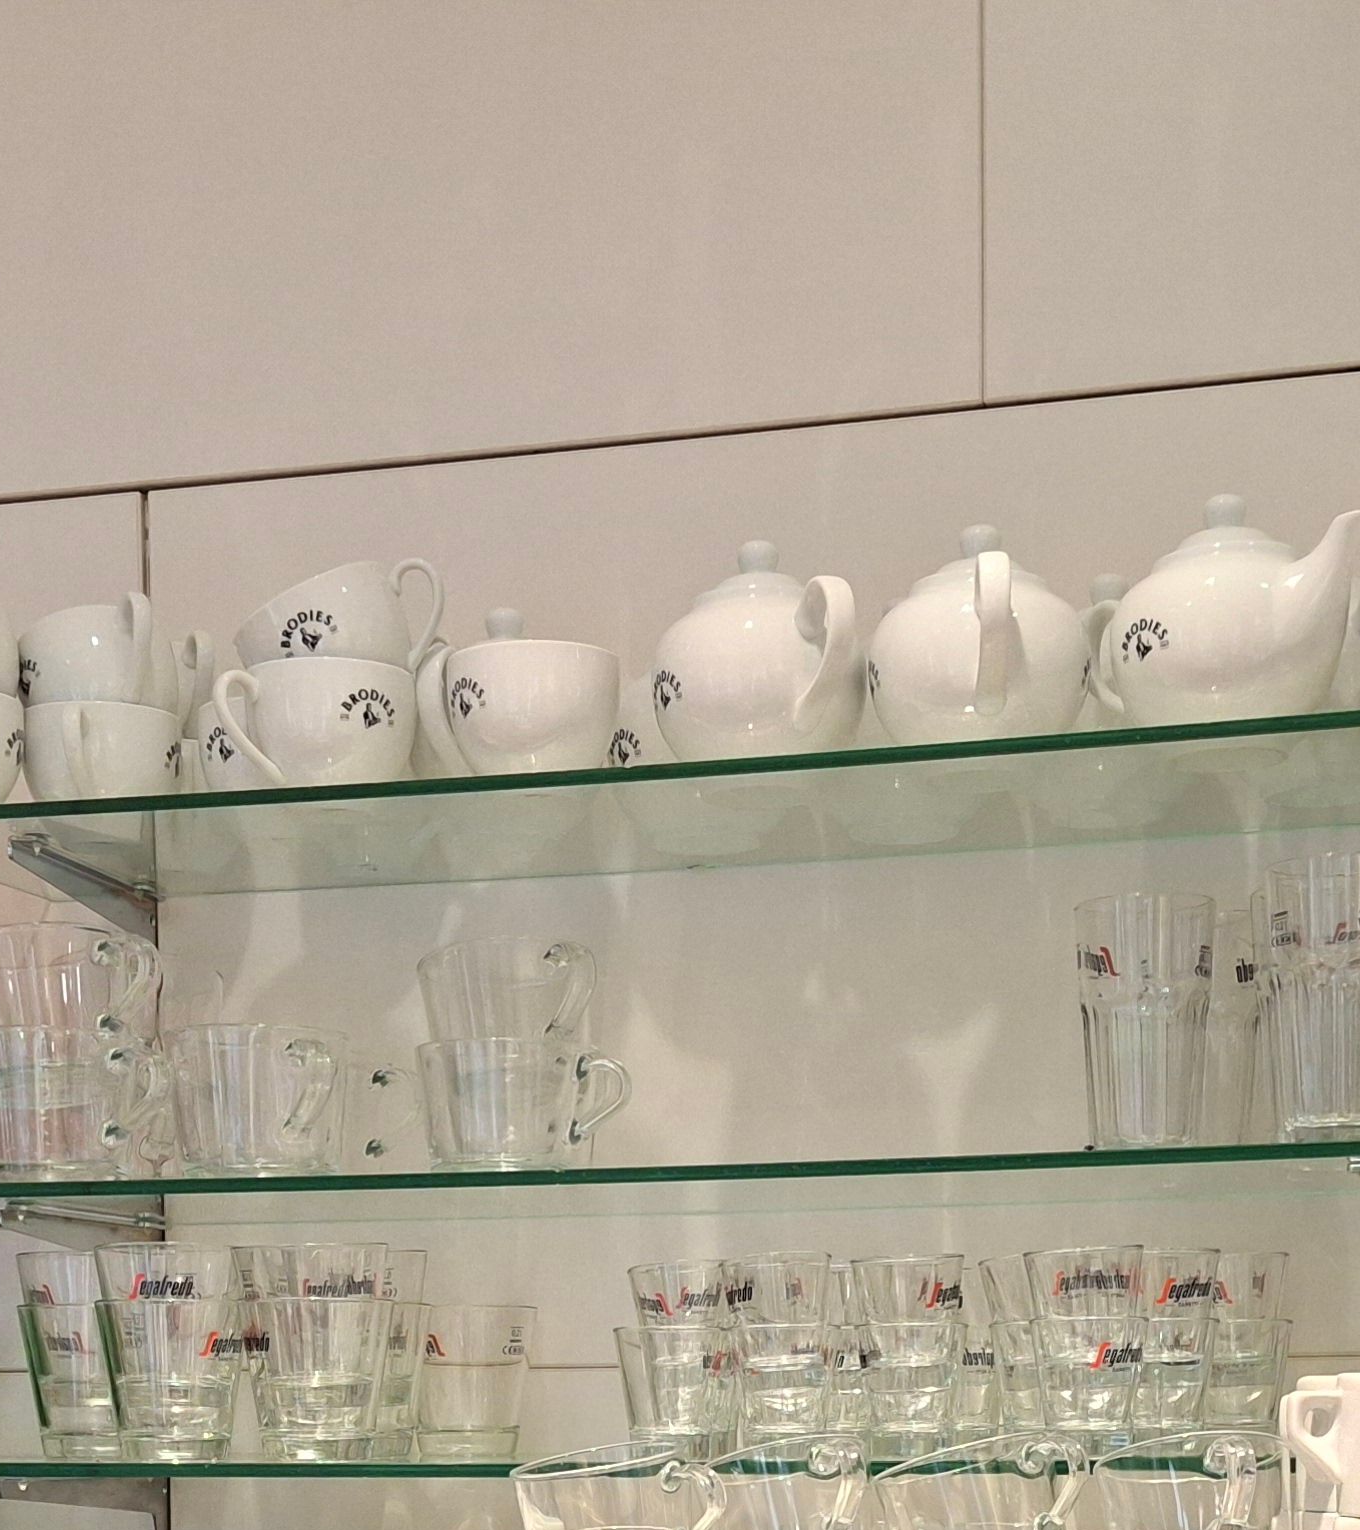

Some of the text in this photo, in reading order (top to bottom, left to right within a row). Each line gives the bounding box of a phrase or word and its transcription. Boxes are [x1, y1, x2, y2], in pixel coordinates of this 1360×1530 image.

[280, 609, 333, 650] BRODIES
[1121, 618, 1169, 652] BRODIES
[341, 688, 396, 718] BRODIES
